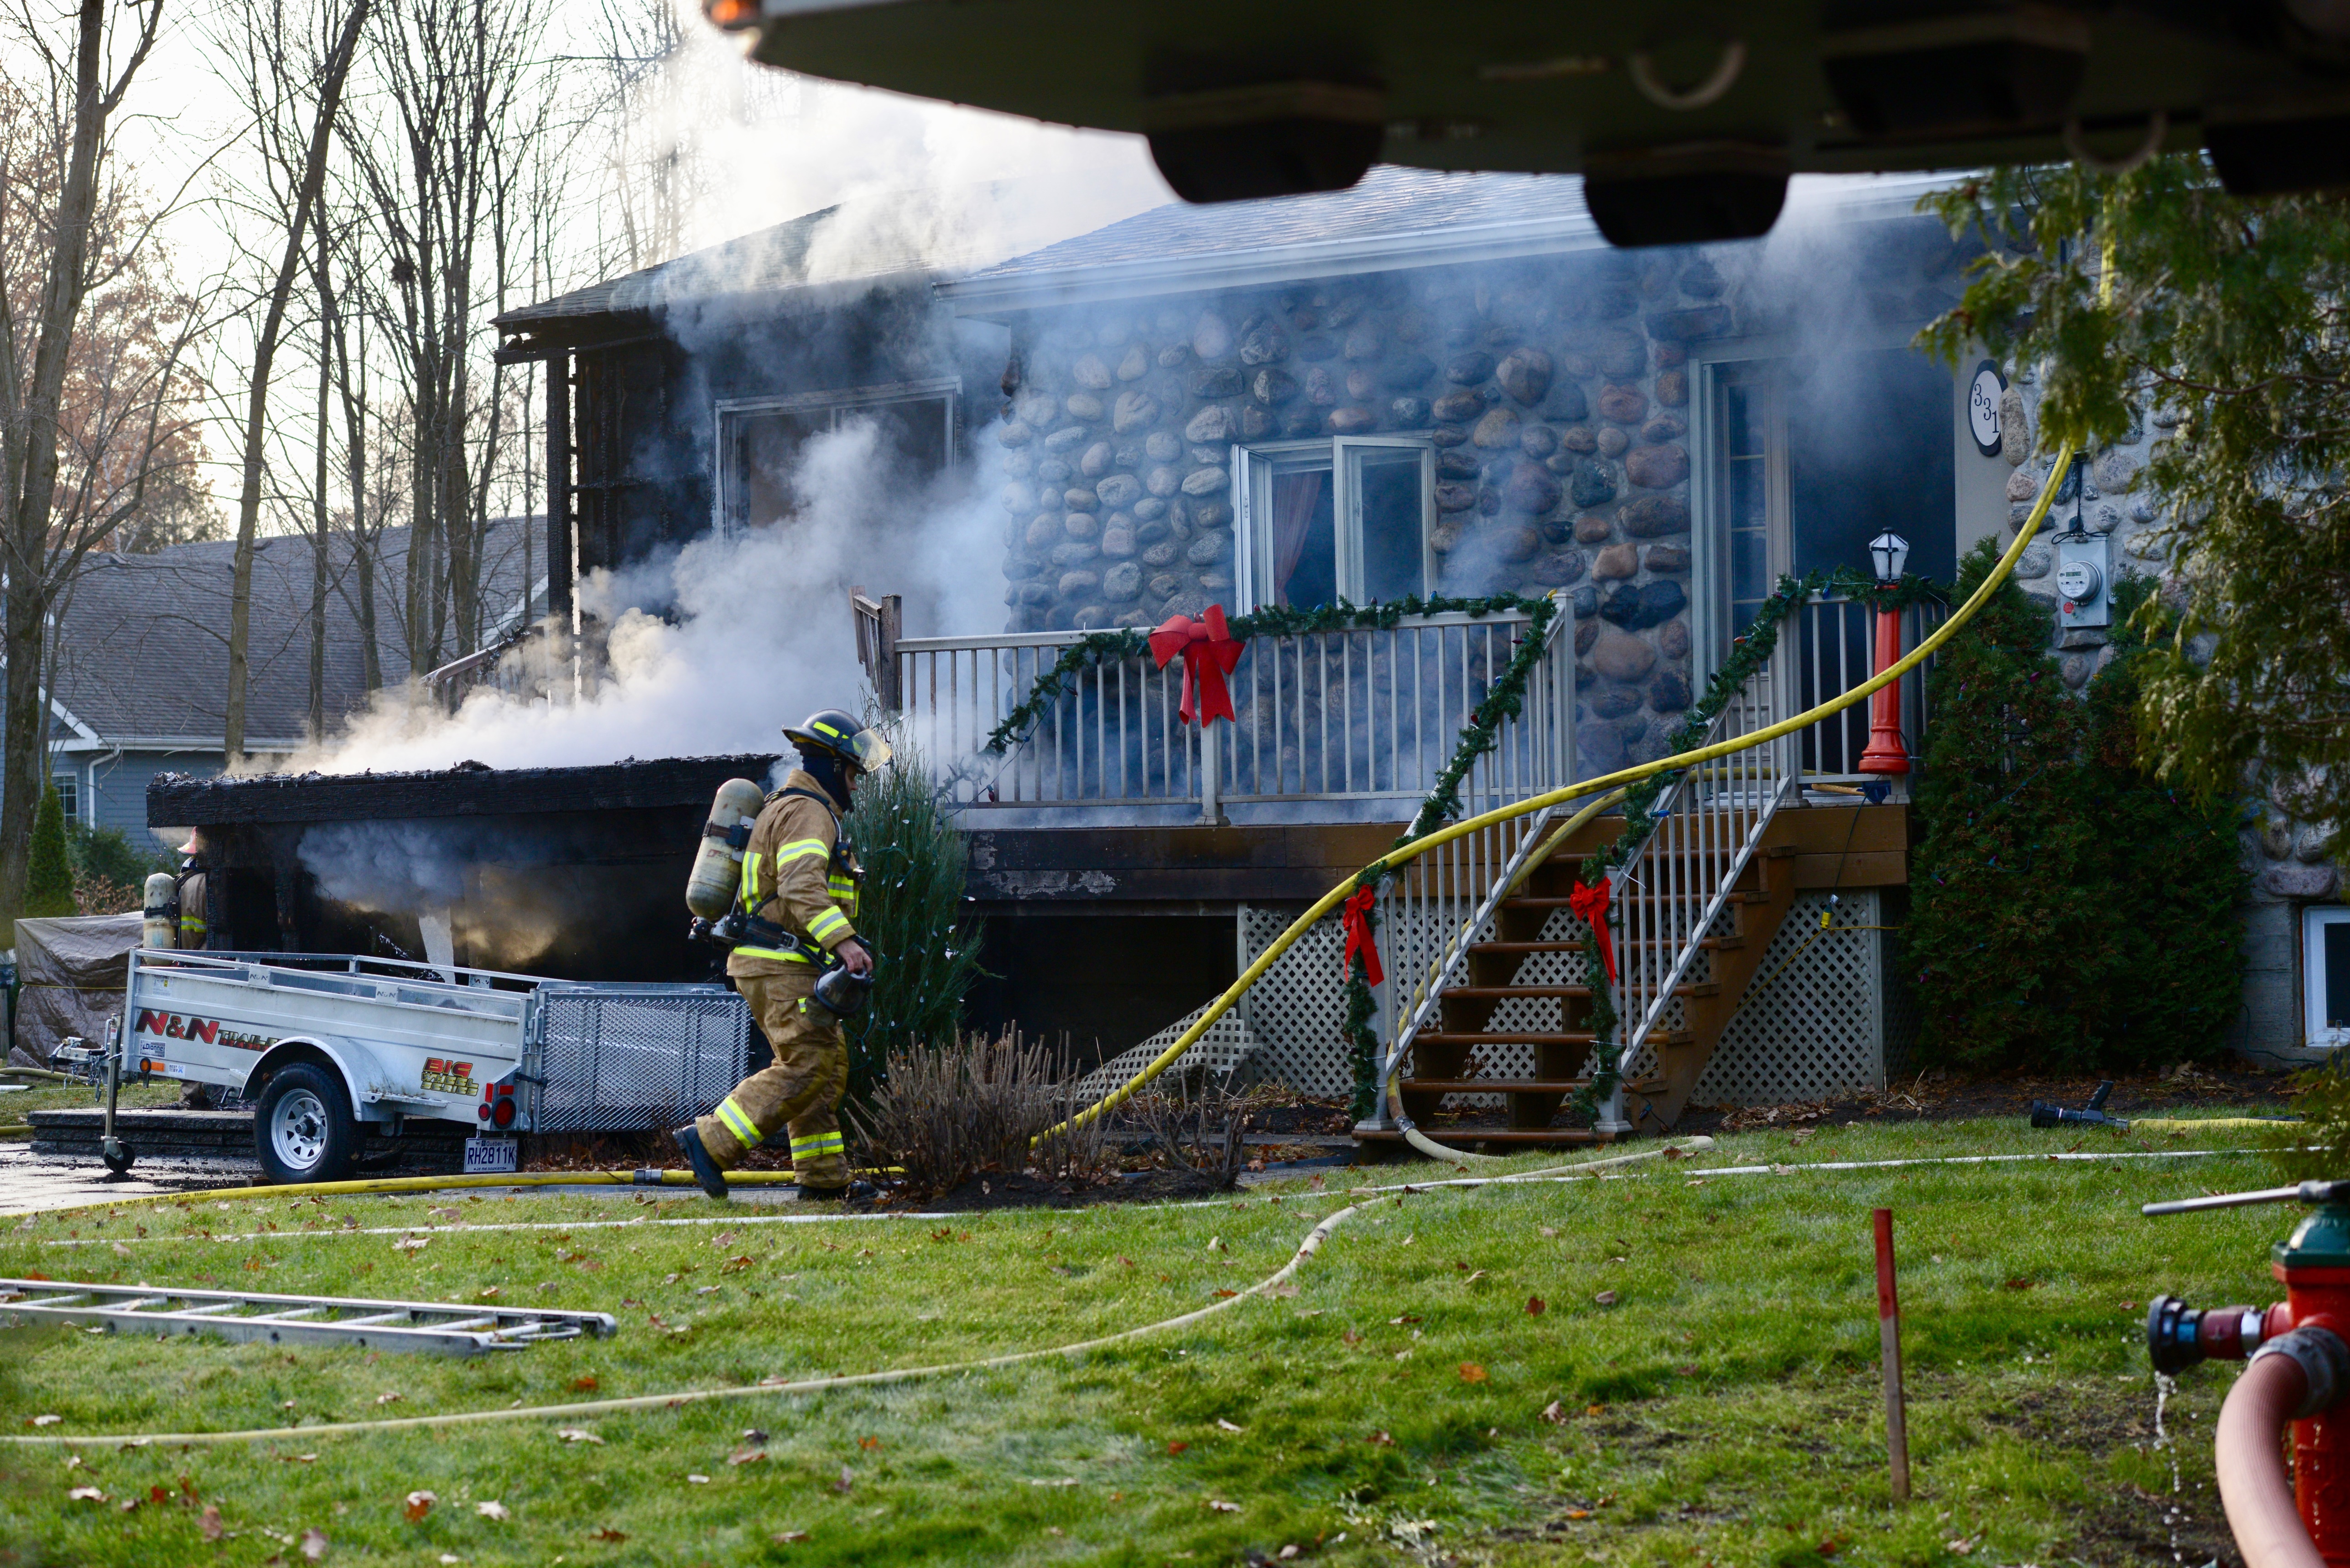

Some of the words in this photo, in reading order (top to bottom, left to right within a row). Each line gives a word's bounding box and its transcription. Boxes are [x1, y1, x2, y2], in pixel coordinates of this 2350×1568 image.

[1974, 384, 1999, 433] 331
[135, 1010, 219, 1044] N&N
[218, 1029, 283, 1046] TRAILE
[143, 1043, 163, 1051] Dionne
[423, 1057, 473, 1078] BIG
[421, 1072, 479, 1088] WHEEL
[421, 1081, 478, 1096] SERIES
[468, 1147, 515, 1164] RH2811K
